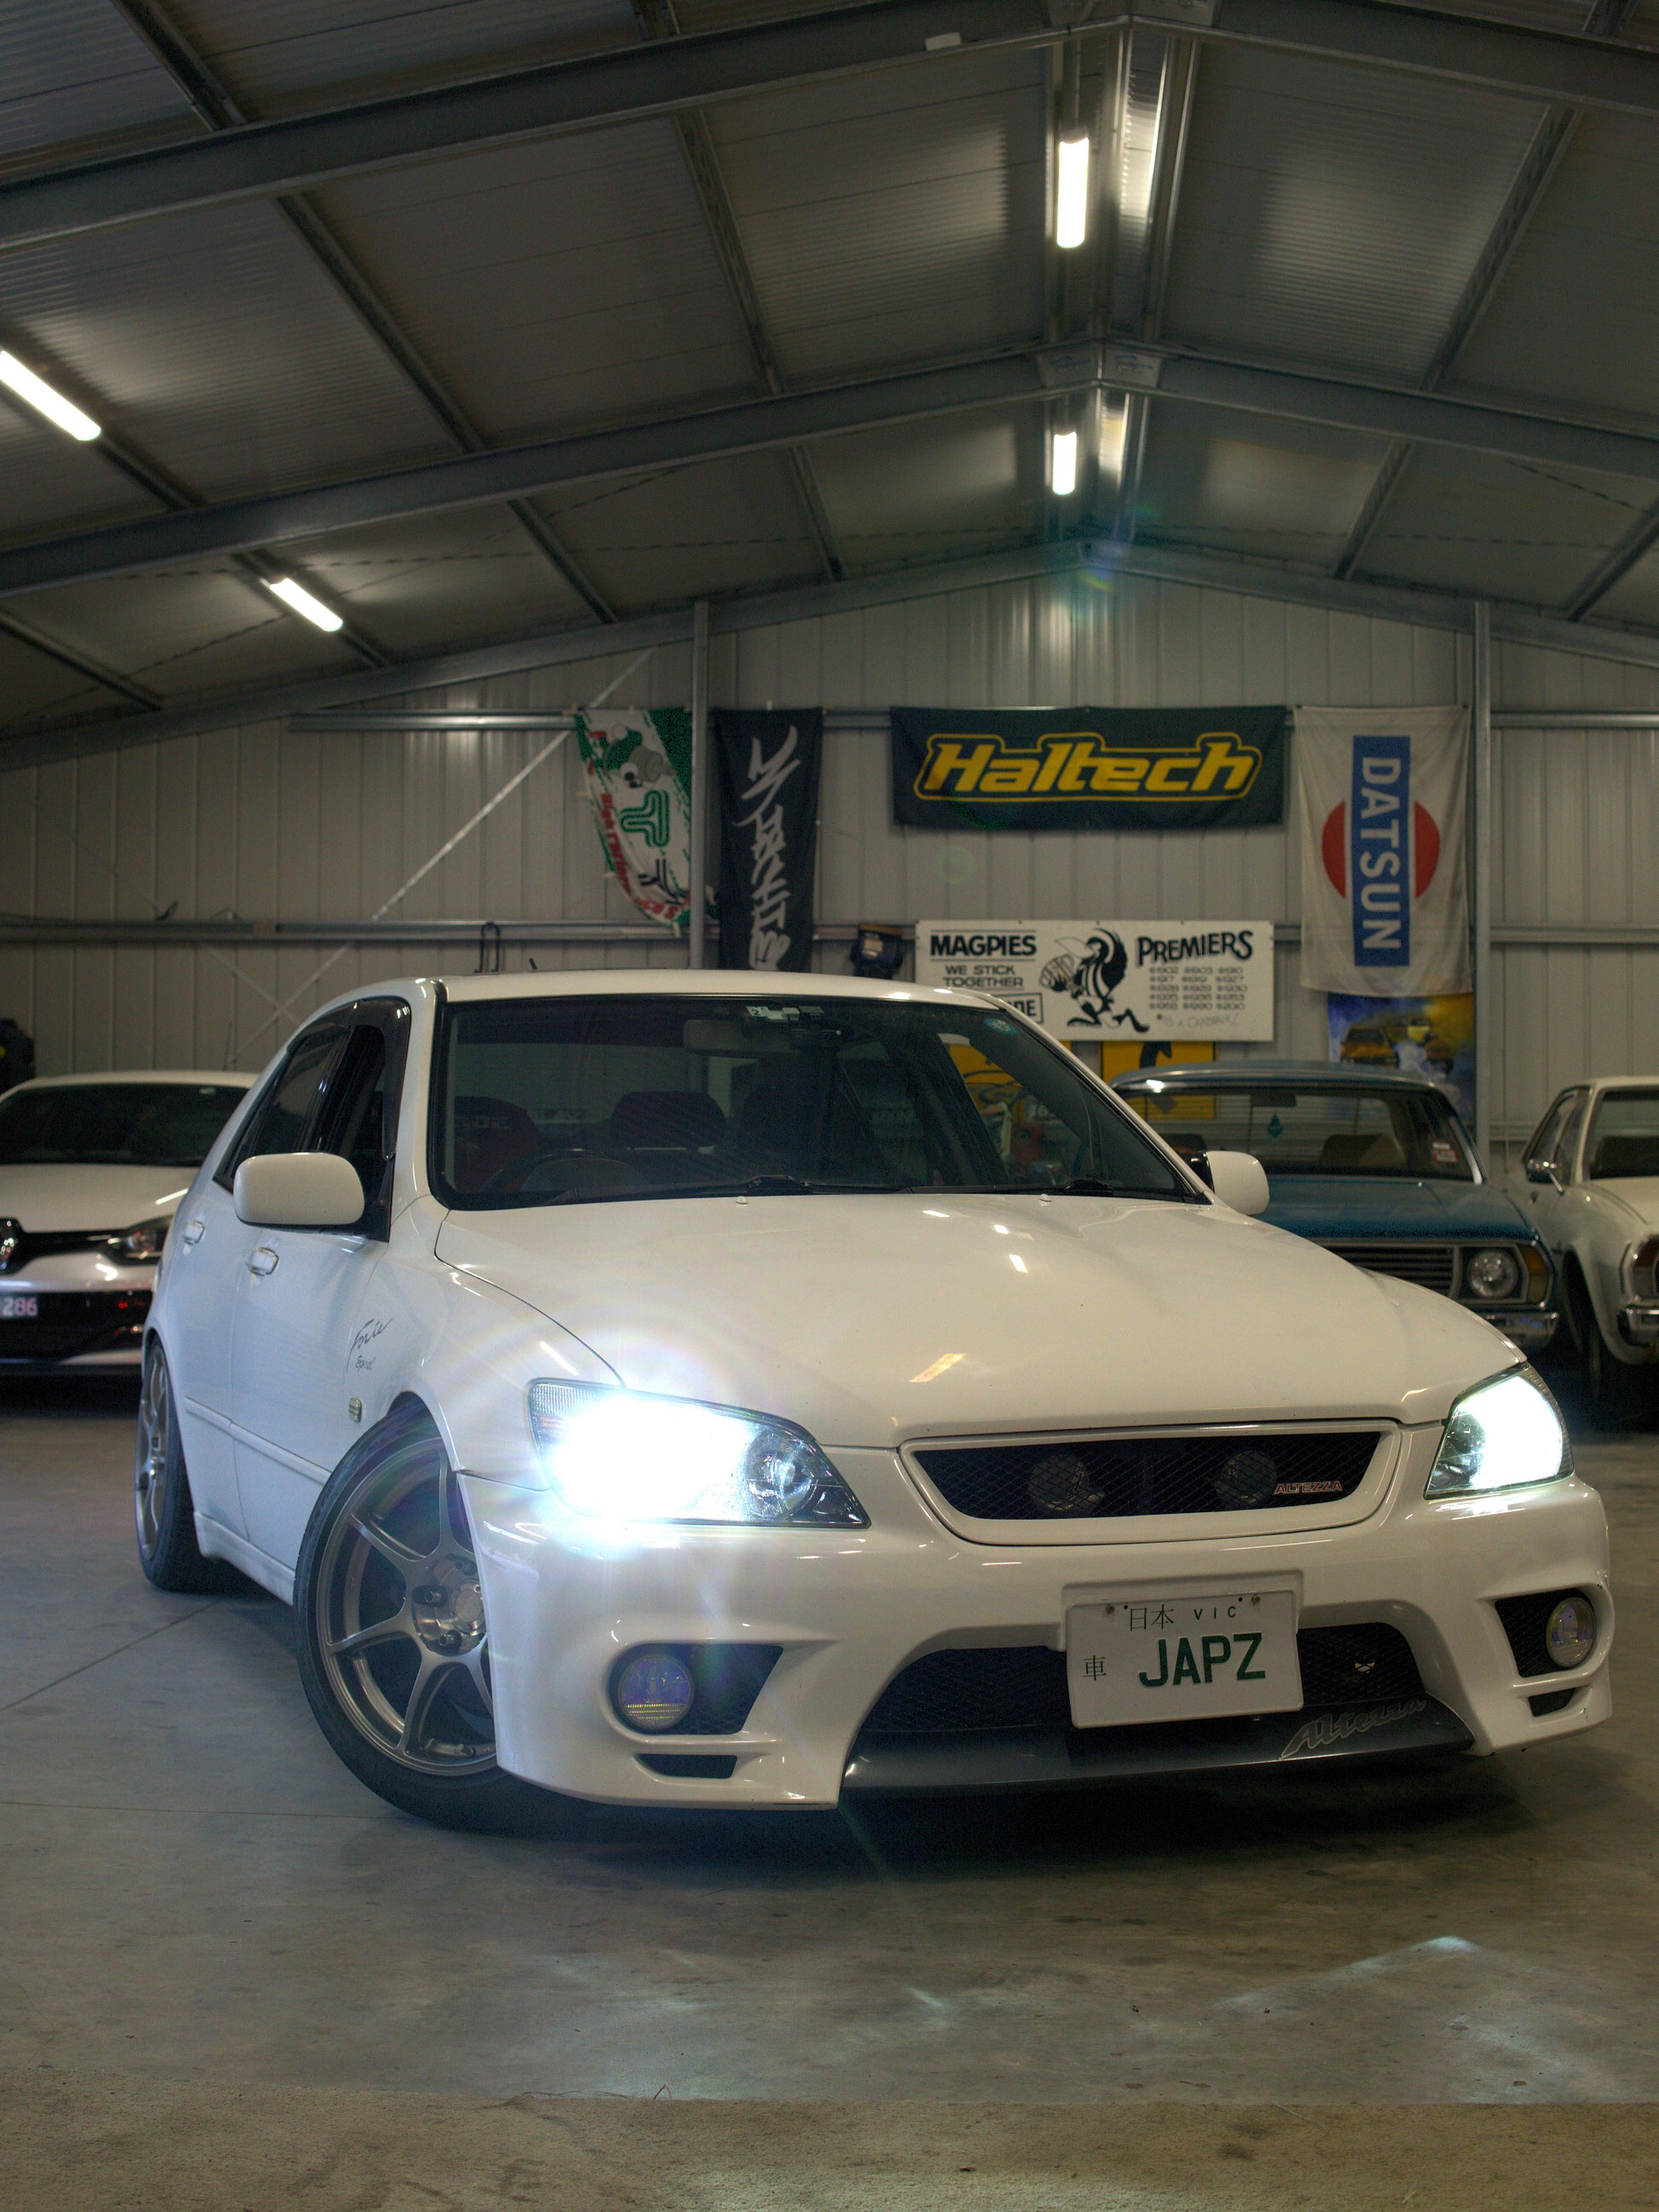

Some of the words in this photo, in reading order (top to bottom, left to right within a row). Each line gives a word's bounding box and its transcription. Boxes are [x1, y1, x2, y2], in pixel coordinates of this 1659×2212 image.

[924, 742, 1255, 792] Haltech
[1360, 757, 1402, 949] DATSUN
[930, 934, 1037, 956] MAGPIES
[1138, 930, 1254, 967] PREMIERS
[943, 976, 1024, 987] TOGETHER
[945, 964, 967, 976] WE
[973, 964, 1015, 976] STICK
[1274, 1480, 1344, 1495] ALTEZZA
[1130, 1603, 1174, 1632] 日本
[1194, 1605, 1236, 1620] VIC
[1083, 1655, 1107, 1681] 車
[1138, 1632, 1266, 1688] JAPZ
